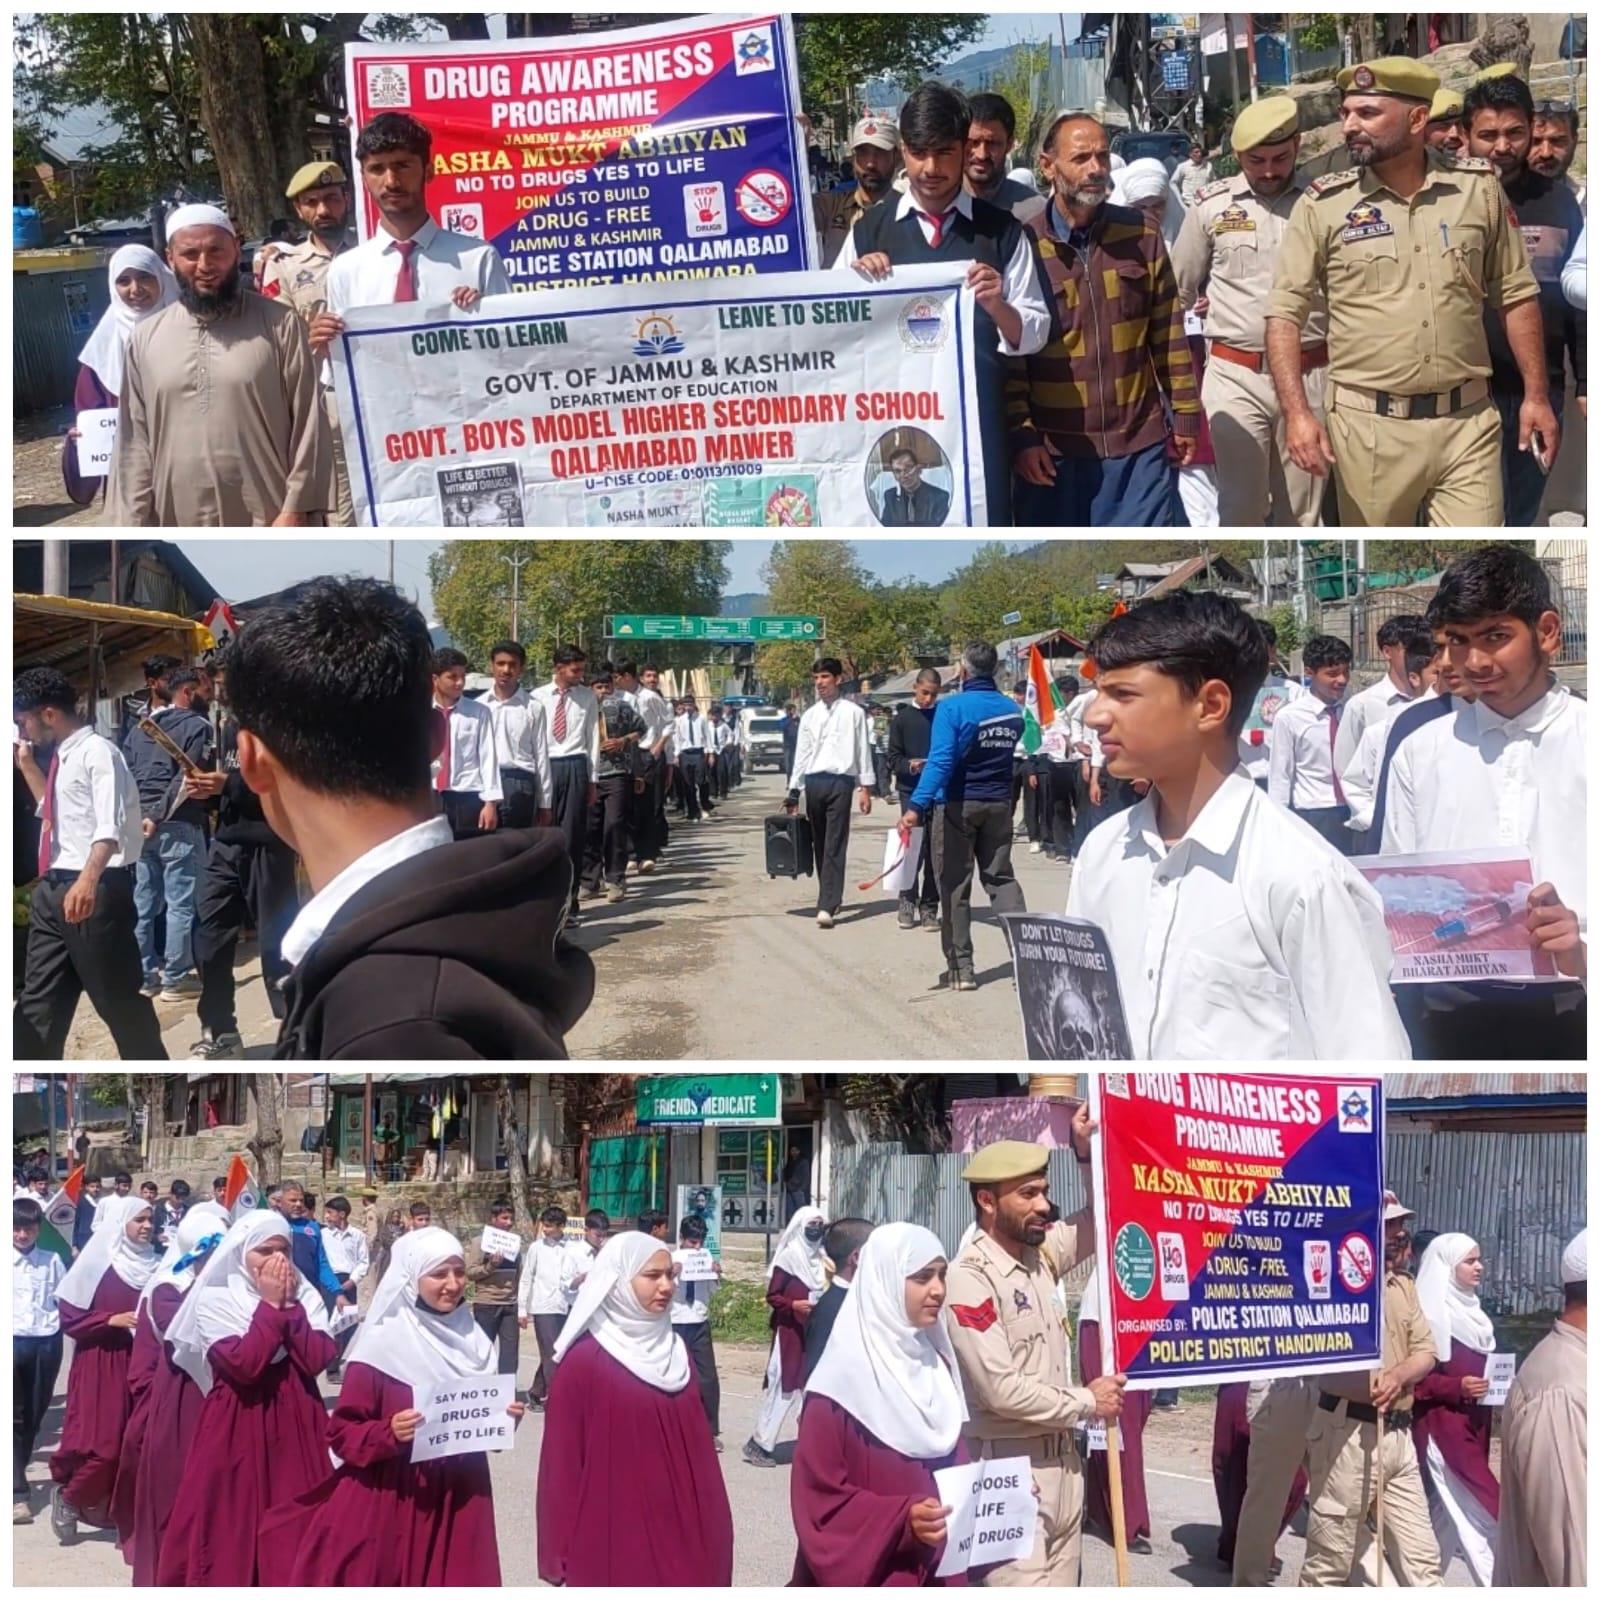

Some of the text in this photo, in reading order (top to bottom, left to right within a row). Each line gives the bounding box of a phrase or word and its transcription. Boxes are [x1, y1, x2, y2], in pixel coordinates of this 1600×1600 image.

[424, 41, 714, 100] DRUG AWARENESS
[491, 89, 659, 128] PROGRAMME
[504, 131, 560, 146] JAMMU
[581, 124, 652, 140] KASHMIR
[433, 126, 747, 175] ASHA MUKT ABHIYAN
[456, 157, 705, 192] NO TO DRUGS YES TO LIFE
[515, 186, 650, 210] JOIN US TO BUILD
[694, 186, 718, 196] STOP
[517, 219, 528, 232] A
[533, 210, 588, 231] DRUG
[607, 206, 651, 225] FREE
[696, 224, 723, 233] DRUGS
[509, 227, 663, 253] JAMMU & KASHMIR
[503, 234, 790, 277] OLICE STATION QALAMABAD
[718, 299, 872, 330] LEAVE TO SERVE
[412, 321, 569, 357] COME TO LEARN
[485, 350, 836, 396] GOVT. OF JAMMU & KASHMIR
[550, 379, 778, 410] DEPARTMENT OF EDUCATION
[385, 391, 945, 463] GOVT. BOYS MODEL HIGHER SECONDARY SCHOOL
[91, 453, 113, 463] NO
[550, 429, 795, 480] QALAMABAD MAWER
[444, 466, 508, 484] LIFE IS BETTER
[638, 469, 678, 484] CODE:
[444, 481, 478, 495] WITHOUT
[607, 509, 644, 523] NASHA
[648, 505, 681, 519] MUKT
[978, 726, 1017, 741] DYSSO
[1021, 923, 1095, 949] DON'T LET DRUGS
[1019, 942, 1108, 972] BURN YOUR FUTURE!
[1413, 953, 1490, 966] NASHA MUKT
[1402, 963, 1508, 977] BHARAT ABHIYAN
[654, 1095, 757, 1116] FRIENDS MEDICATE
[1134, 1073, 1321, 1125] DRUG AWARENESS
[1174, 1114, 1285, 1158] PROGRAMME
[1186, 1156, 1285, 1179] JAMMU & KASHMIR
[1132, 1163, 1352, 1208] NASHA MUKT ABHIYAN
[1162, 1200, 1183, 1219] NO
[1187, 1203, 1205, 1221] TO
[1243, 1208, 1269, 1226] YES
[1273, 1210, 1292, 1227] TO
[1295, 1212, 1324, 1228] LIFE
[1202, 1231, 1227, 1248] JOIN
[1228, 1233, 1243, 1249] US
[1206, 1259, 1215, 1275] A
[1214, 1256, 1249, 1276] DRUG
[1260, 1257, 1289, 1277] FREE
[1204, 1283, 1240, 1300] JAMMU
[1242, 1282, 1250, 1300] &
[1251, 1283, 1294, 1300] KASHMIR
[1118, 1302, 1369, 1333] ORGANISED BY: POLICE STATION QALAMABAD
[1150, 1331, 1353, 1364] POLICE DISTRICT HANDWARA
[435, 1388, 499, 1405] SAY NO TO
[441, 1407, 491, 1424] DRUGS
[428, 1426, 506, 1446] YES TO LIFE
[975, 1502, 1006, 1518] LIFE
[978, 1526, 1024, 1545] DRUGS
